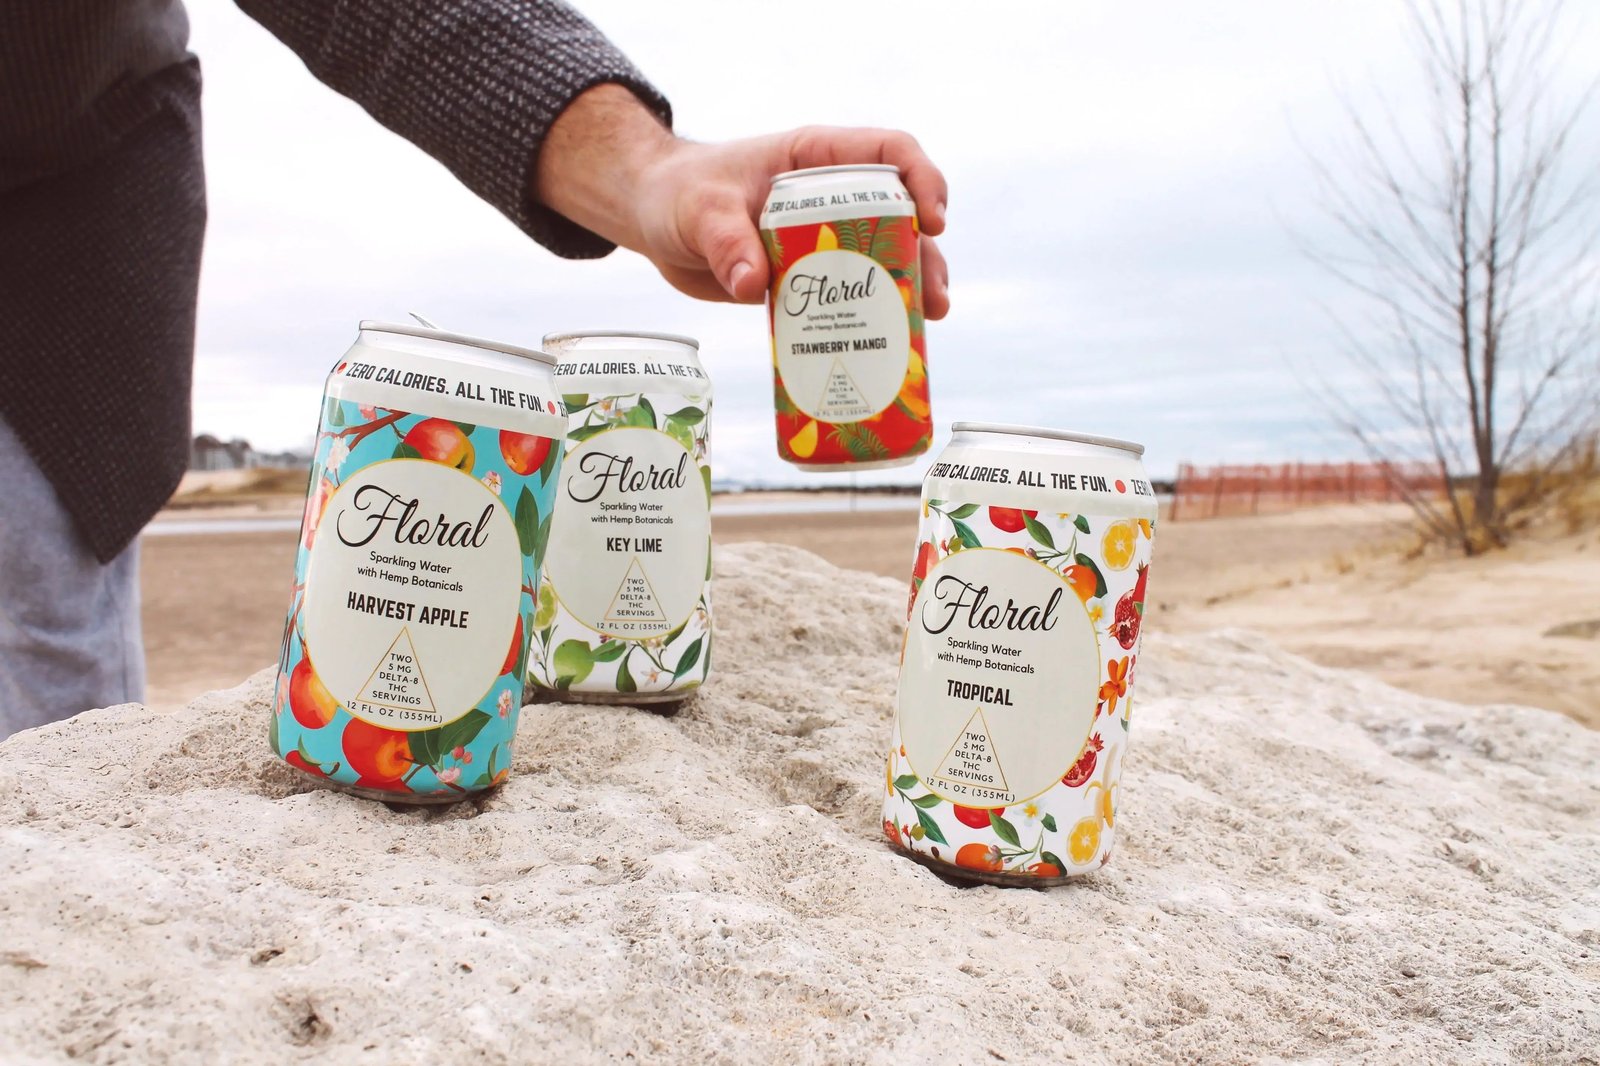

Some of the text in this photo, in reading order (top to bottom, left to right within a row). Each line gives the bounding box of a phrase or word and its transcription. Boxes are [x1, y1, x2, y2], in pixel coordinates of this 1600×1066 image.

[830, 194, 849, 205] ALL
[852, 192, 870, 203] THE
[783, 266, 876, 317] Floral
[791, 337, 887, 355] STRAWBERRY MANGO
[553, 363, 577, 376] ZERO
[579, 362, 640, 375] CALORIES.
[644, 363, 666, 375] ALL
[667, 364, 687, 377] THE
[346, 362, 376, 380] ZERO
[375, 367, 450, 395] CALORIES.
[455, 381, 485, 401] ALL
[490, 387, 516, 407] THE
[519, 393, 545, 413] FUN.
[567, 451, 688, 503] Floral
[949, 464, 1012, 485] CALORIES.
[1017, 470, 1046, 488] ALL
[1050, 473, 1077, 490] THE
[1081, 475, 1111, 493] FUN.
[600, 502, 663, 512] Sparkling Water
[336, 484, 494, 548] Floral
[591, 515, 674, 525] with Hemp Botanicals
[606, 537, 662, 553] KEY LIME
[369, 551, 452, 574] Sparkling Water
[357, 566, 464, 592] with Hemp Botanicals
[347, 591, 469, 629] HARVEST APPLE
[922, 575, 1063, 634] Floral
[947, 636, 1022, 657] Sparkling Water
[391, 653, 412, 663] TWO
[937, 651, 1035, 674] with Hemp Botanicals
[397, 665, 412, 674] MG
[379, 672, 419, 685] DELTA-8
[388, 683, 407, 693] THC
[947, 679, 1013, 706] TROPICAL
[372, 690, 421, 705] SERVINGS
[347, 701, 443, 723] 12 FL OZ (355ML)
[966, 732, 986, 742] TWO
[955, 750, 992, 763] DELTA-8
[971, 744, 985, 752] MG
[963, 761, 980, 771] THC
[948, 768, 994, 783] SERVINGS
[926, 777, 1016, 803] 12 FL OZ (355ML)
